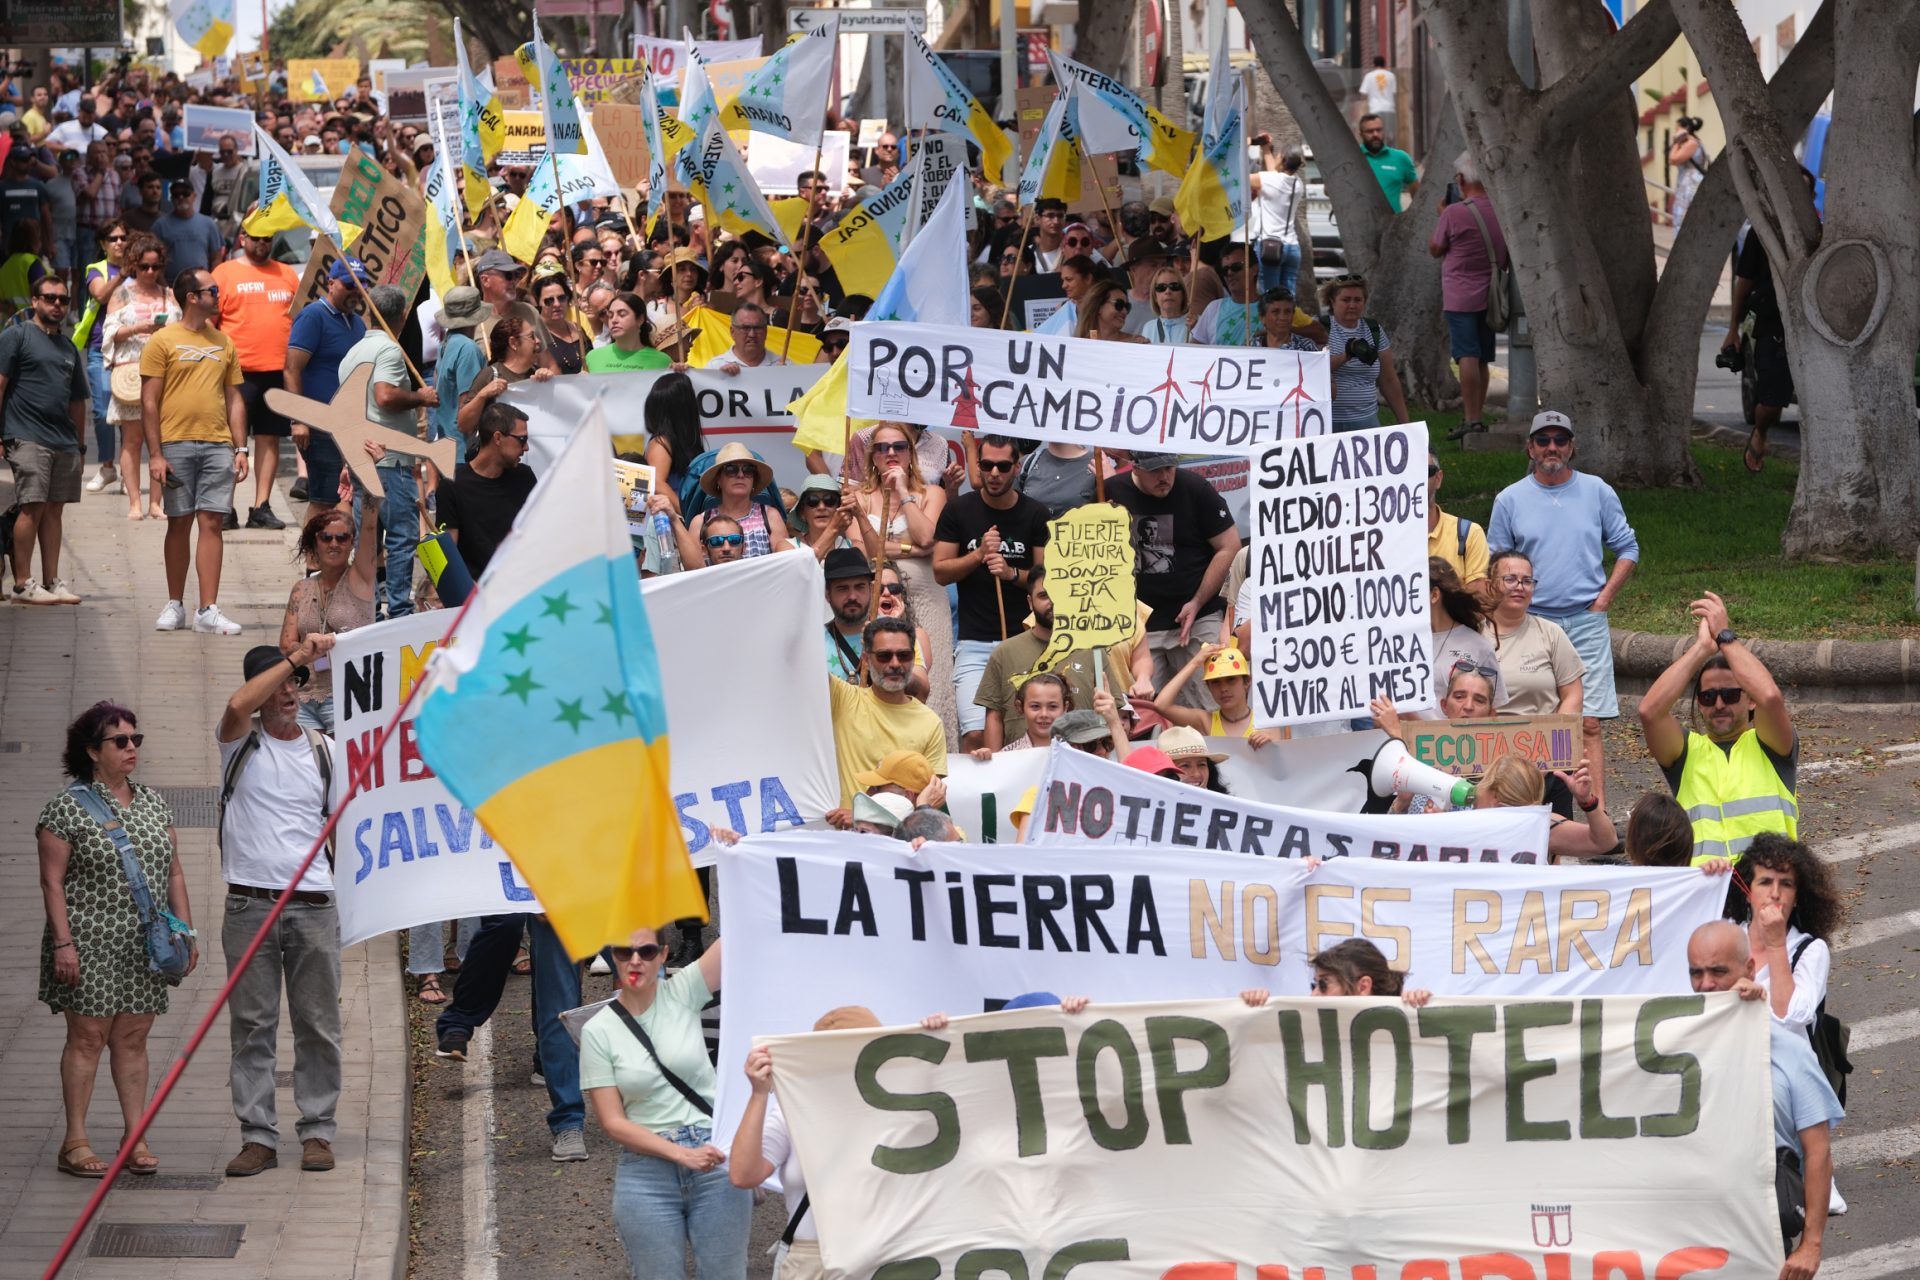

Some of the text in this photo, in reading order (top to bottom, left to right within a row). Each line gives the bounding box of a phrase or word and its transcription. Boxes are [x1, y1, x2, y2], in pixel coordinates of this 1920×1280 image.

[841, 14, 923, 27] ayuntamieto
[939, 156, 952, 170] EL
[867, 338, 974, 402] POR
[1008, 340, 1066, 381] UN
[696, 389, 752, 418] OR
[1258, 431, 1409, 489] SALARIO
[1054, 541, 1128, 563] VENTURA
[1055, 520, 1125, 542] FUERTE
[1079, 598, 1102, 613] LA
[1368, 626, 1427, 666] PARA
[344, 651, 384, 721] NI
[1340, 675, 1365, 710] AL
[1369, 663, 1430, 703] MES?
[346, 725, 384, 800] NI
[674, 777, 806, 855] STA
[1044, 780, 1115, 839] NO
[776, 857, 879, 937] LA
[1189, 879, 1281, 967] NO
[1305, 883, 1412, 973] ES
[1451, 887, 1654, 975] RARA
[855, 996, 1705, 1174] STOP HOTELS
